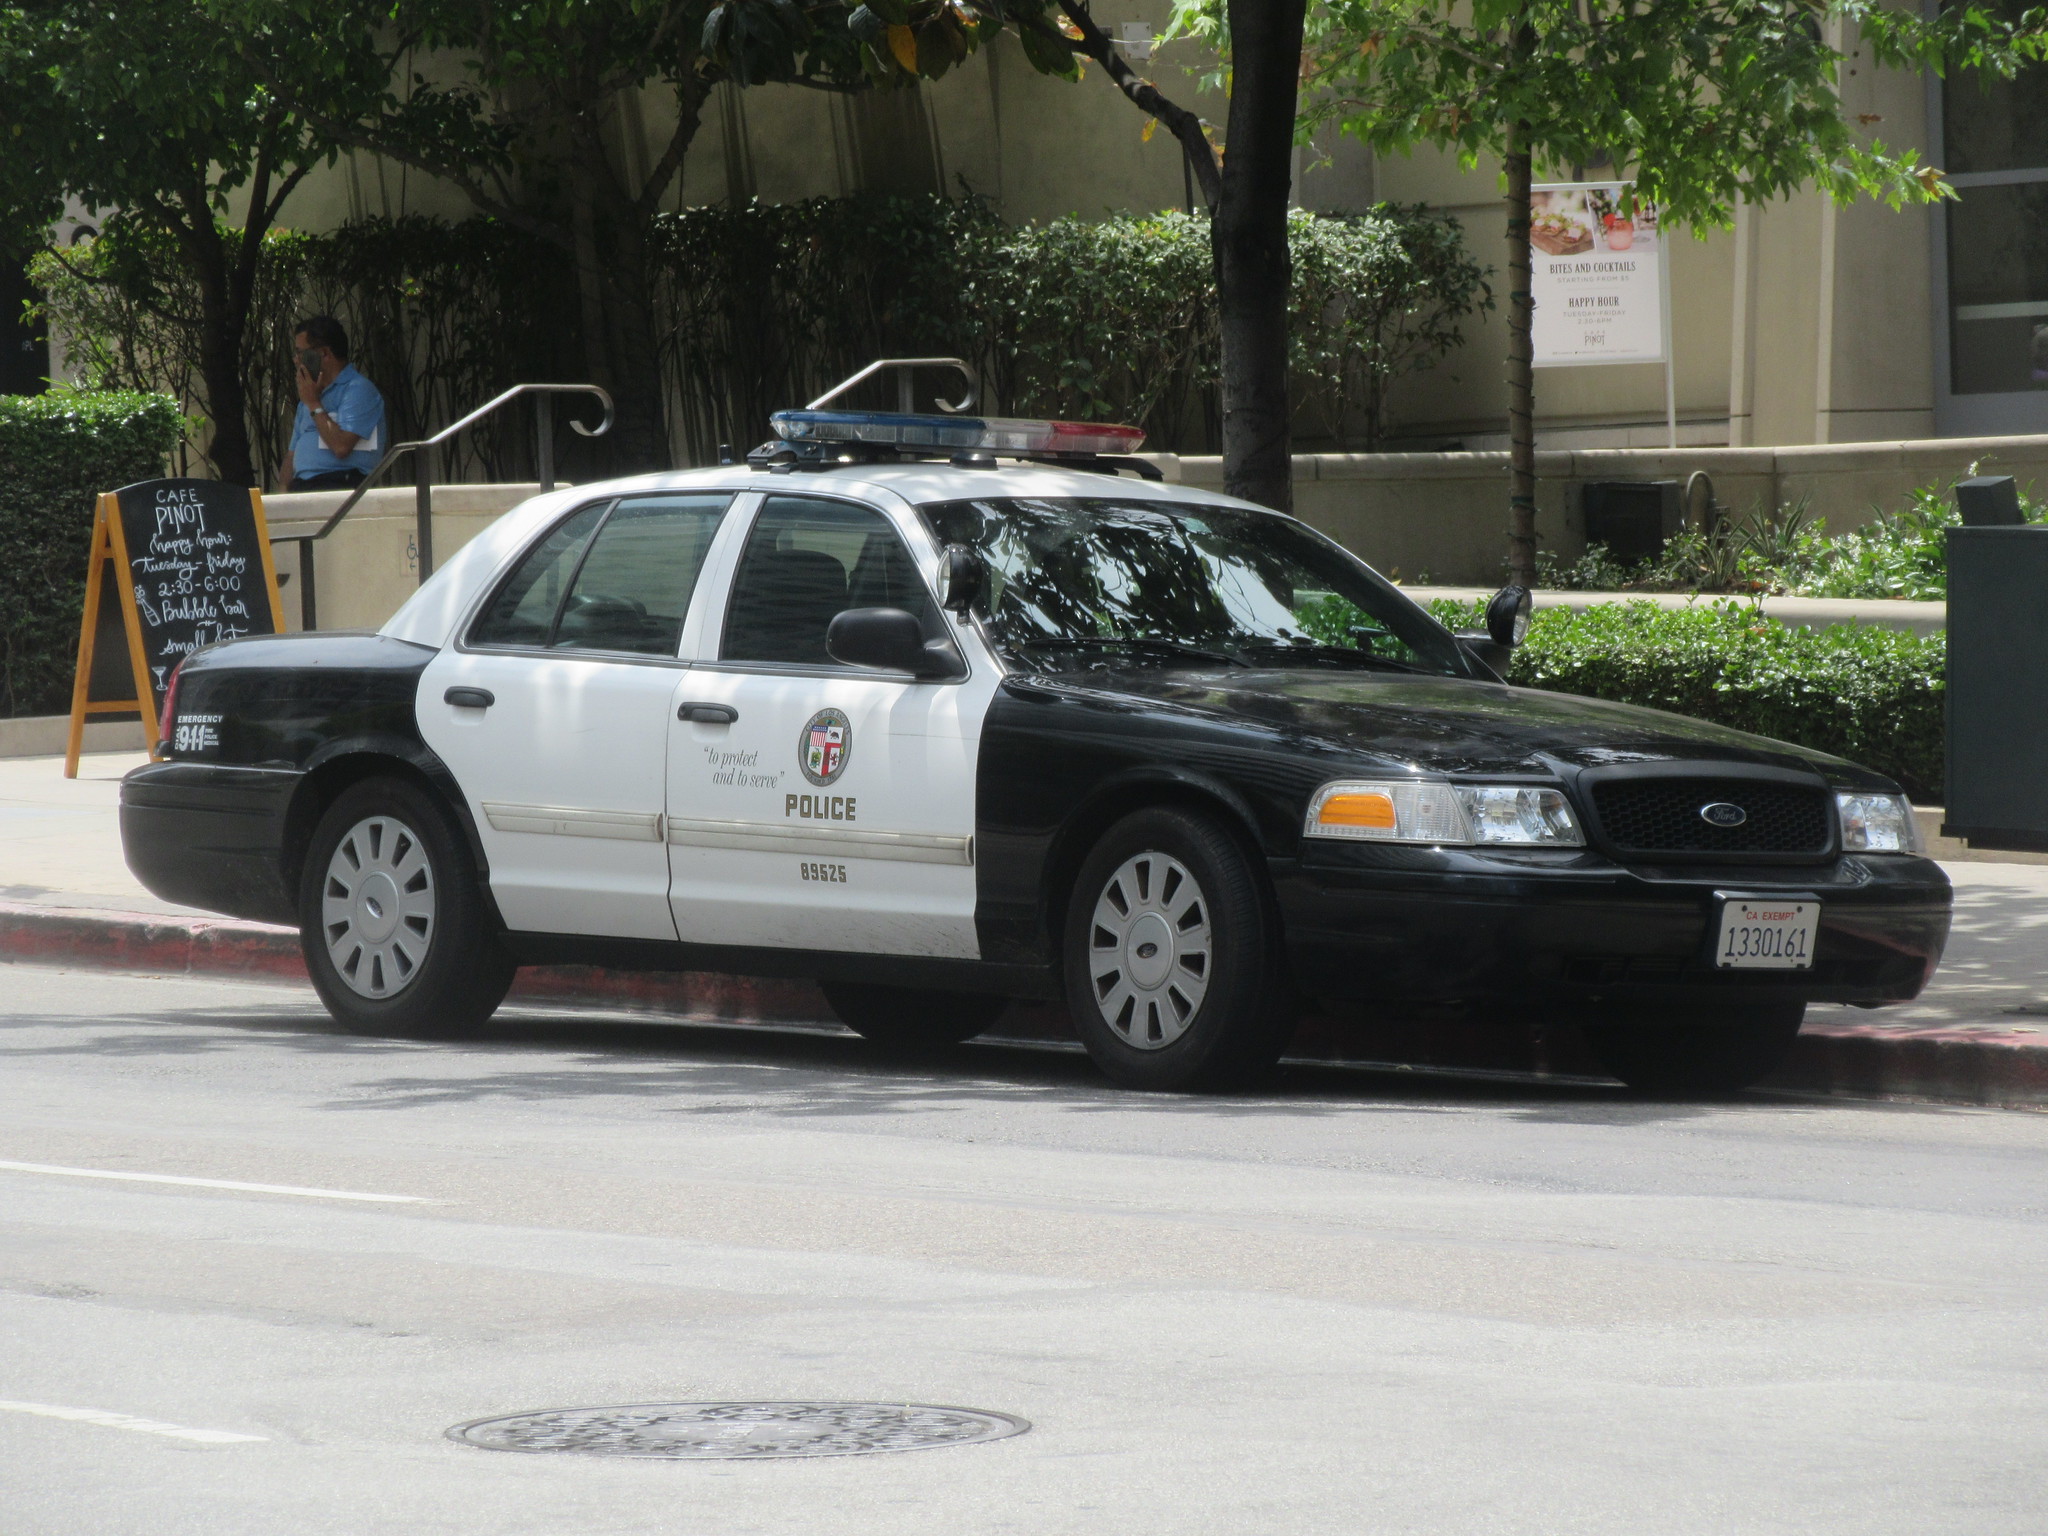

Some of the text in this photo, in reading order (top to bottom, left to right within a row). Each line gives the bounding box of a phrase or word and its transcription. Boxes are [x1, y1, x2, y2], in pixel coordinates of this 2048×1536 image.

[1550, 261, 1636, 274] BITES AND COCKTAILS
[1569, 296, 1620, 308] HAPPY HOUR
[1584, 335, 1605, 346] PINOT
[156, 488, 198, 503] CAFE
[155, 503, 204, 535] PINOT
[149, 533, 193, 556] happy
[162, 596, 217, 623] Bubble
[159, 630, 206, 656] small
[178, 715, 223, 723] EMERGENCY
[720, 749, 758, 769] protect
[712, 768, 736, 785] and
[737, 770, 748, 787] to
[785, 793, 857, 821] POLICE
[1713, 806, 1737, 820] Ford
[800, 862, 847, 883] 89525
[1746, 911, 1796, 921] CA EXEMPT
[1724, 926, 1806, 958] 1330161
